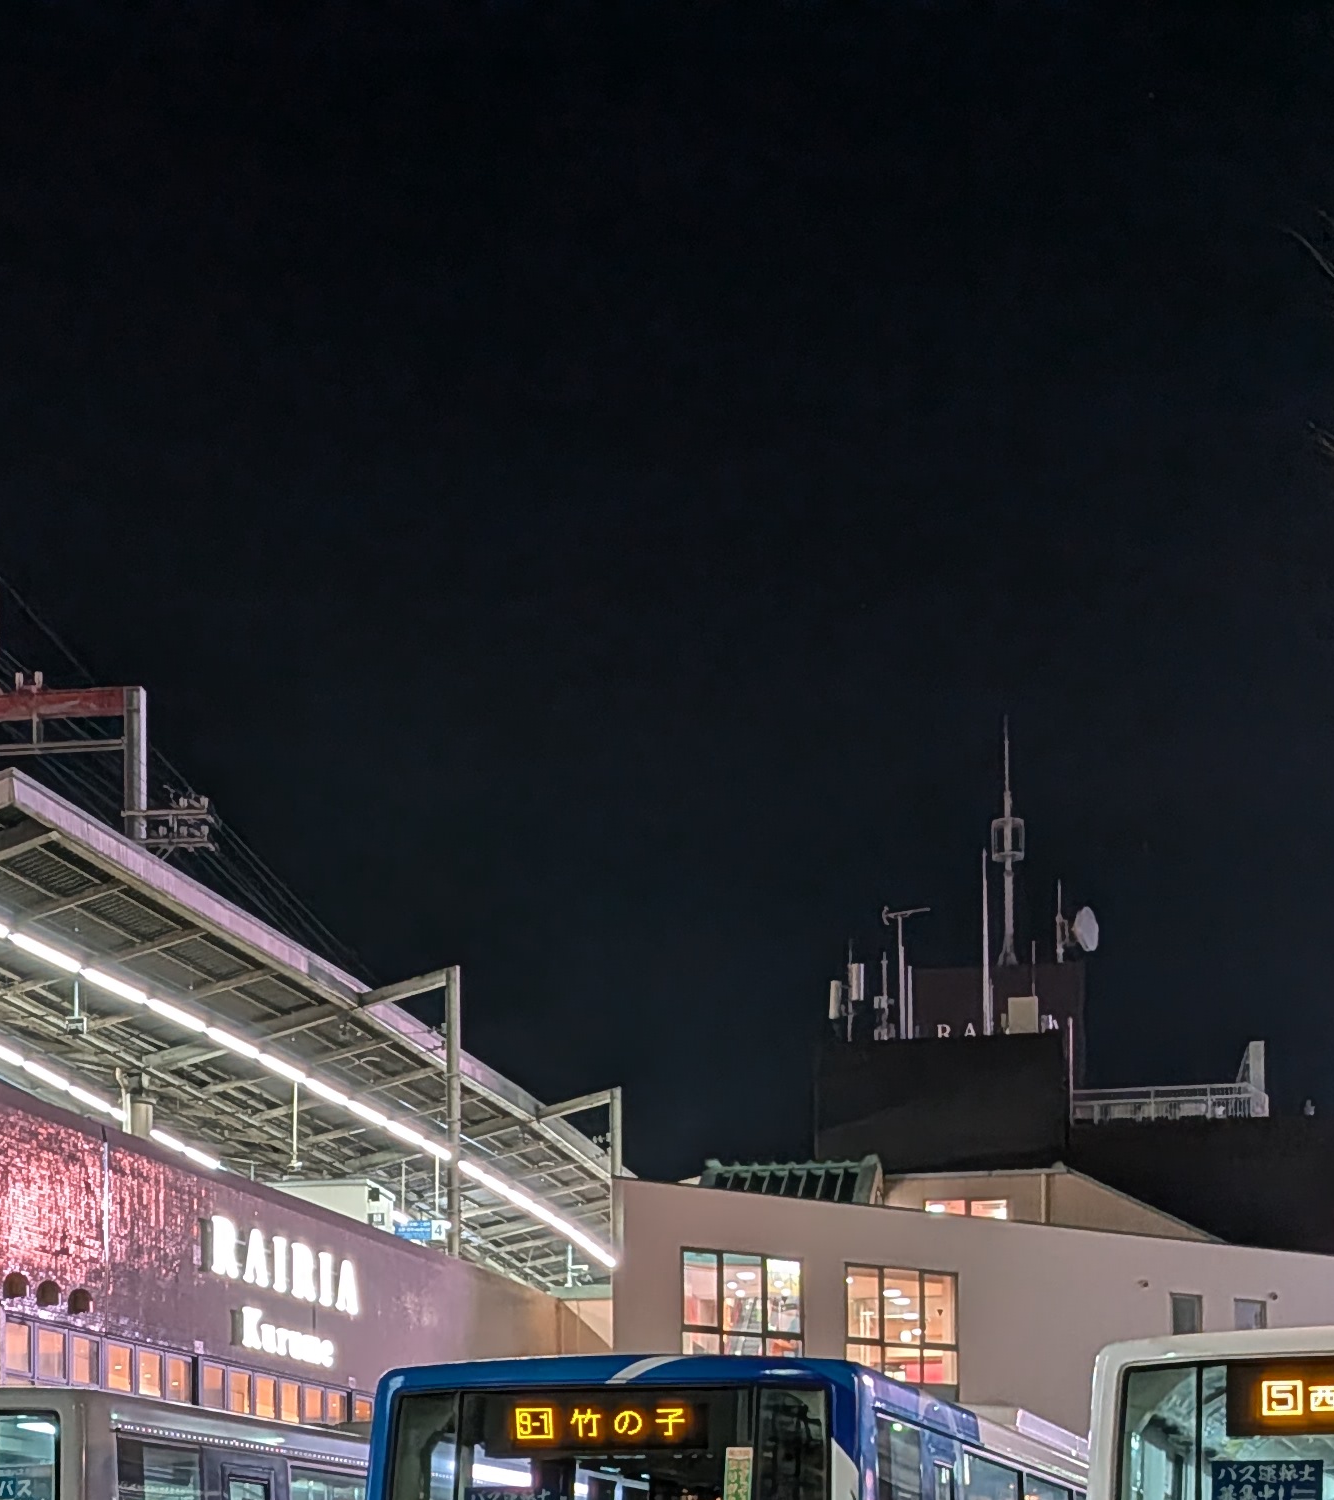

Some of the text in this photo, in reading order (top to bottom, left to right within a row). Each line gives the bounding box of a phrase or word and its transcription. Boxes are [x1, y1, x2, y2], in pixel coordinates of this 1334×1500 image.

[209, 1214, 360, 1316] RAIRIA
[240, 1305, 336, 1368] Kurume
[518, 1408, 686, 1438] 9-1 竹の子
